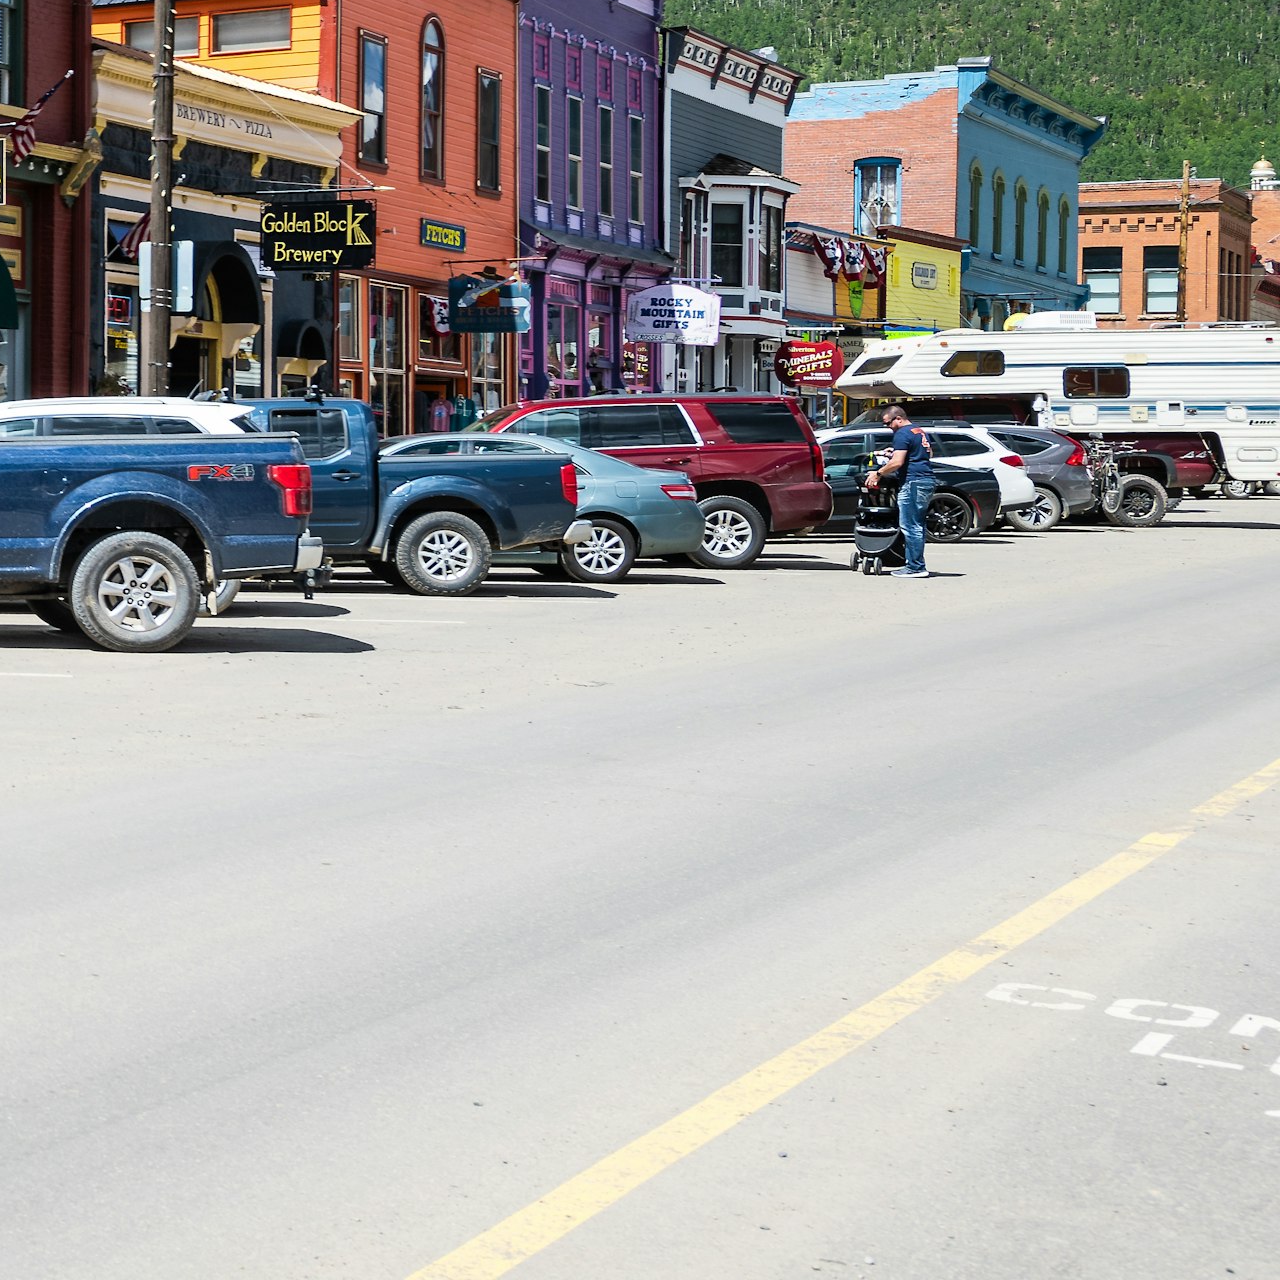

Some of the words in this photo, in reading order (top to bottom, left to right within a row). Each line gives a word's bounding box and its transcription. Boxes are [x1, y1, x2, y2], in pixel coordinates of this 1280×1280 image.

[176, 103, 226, 128] BREWERY
[243, 120, 273, 138] PIZZA
[262, 212, 311, 233] Golden
[426, 224, 461, 246] FETCH'S
[273, 242, 343, 264] Brewery
[650, 298, 693, 307] ROCKY
[640, 308, 705, 319] MOUNTAIN
[653, 320, 689, 329] GIFTS
[778, 350, 833, 368] MINERALS
[797, 360, 832, 373] GIFTS
[187, 464, 255, 480] FX4
